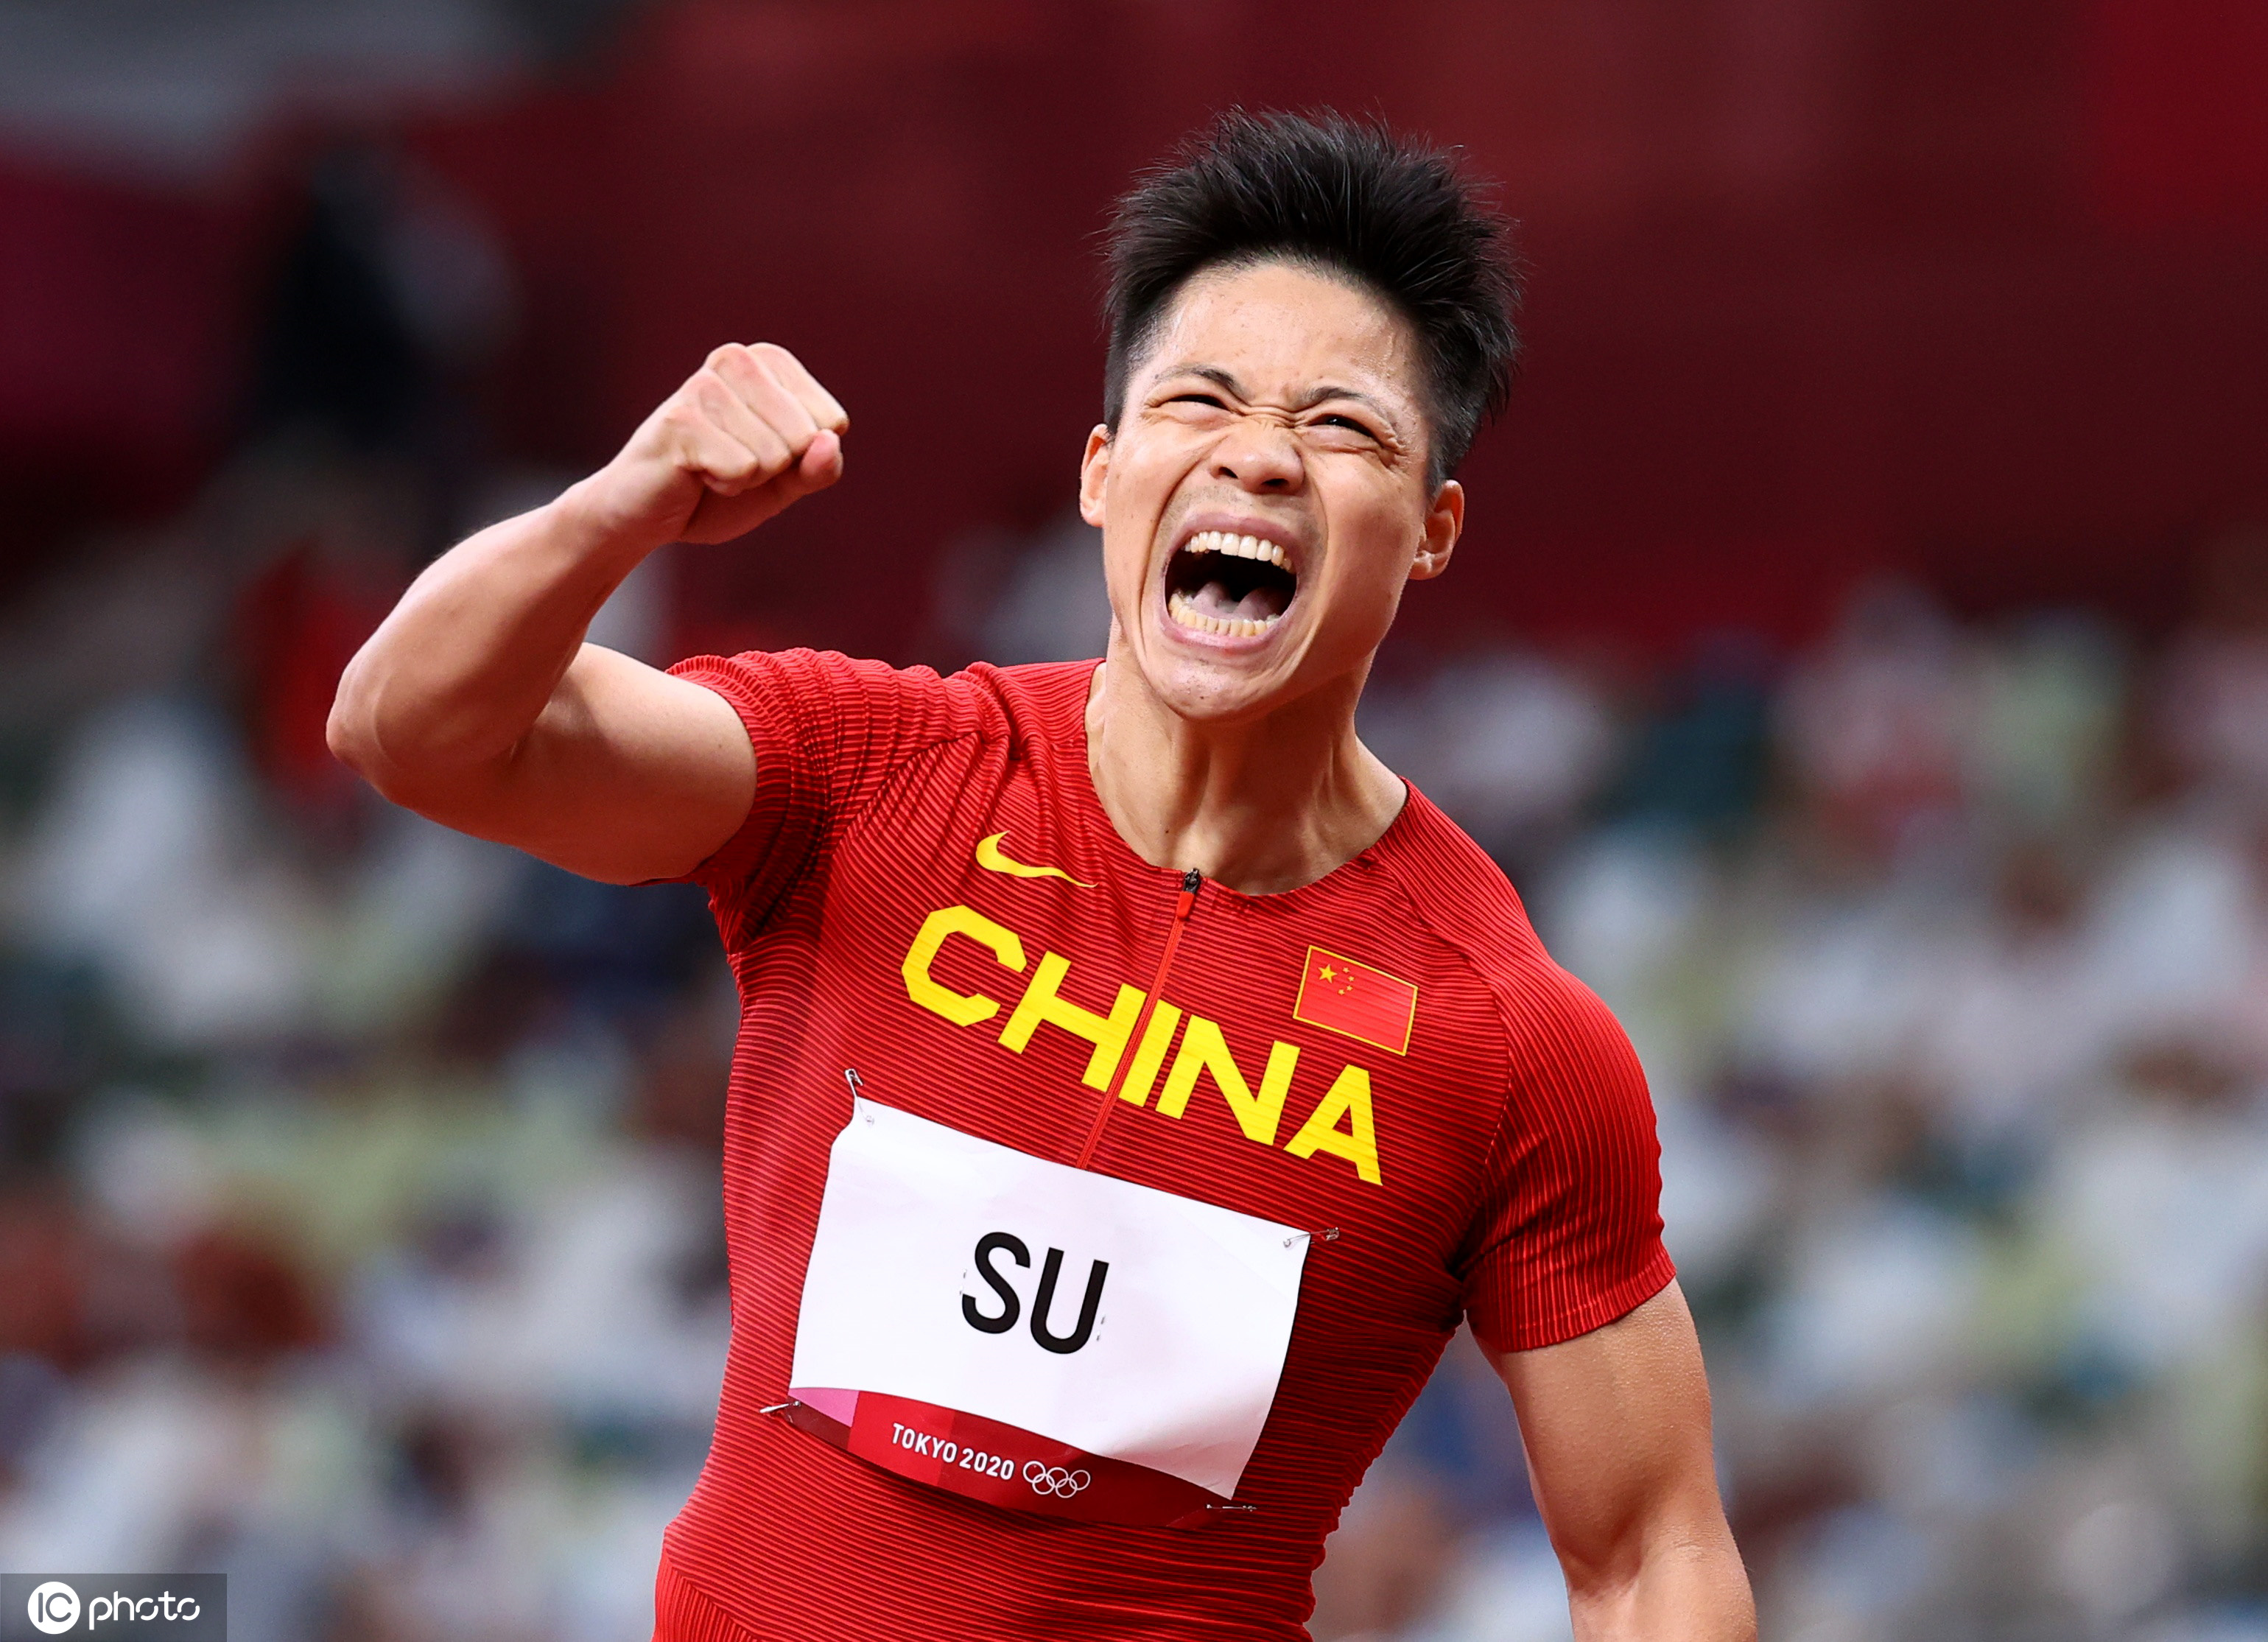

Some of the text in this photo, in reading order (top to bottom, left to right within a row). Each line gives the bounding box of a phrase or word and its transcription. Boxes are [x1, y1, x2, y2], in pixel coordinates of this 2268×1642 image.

[901, 905, 1383, 1186] CHINA
[961, 1232, 1109, 1354] SU
[891, 1422, 1016, 1481] TOKYO 2020
